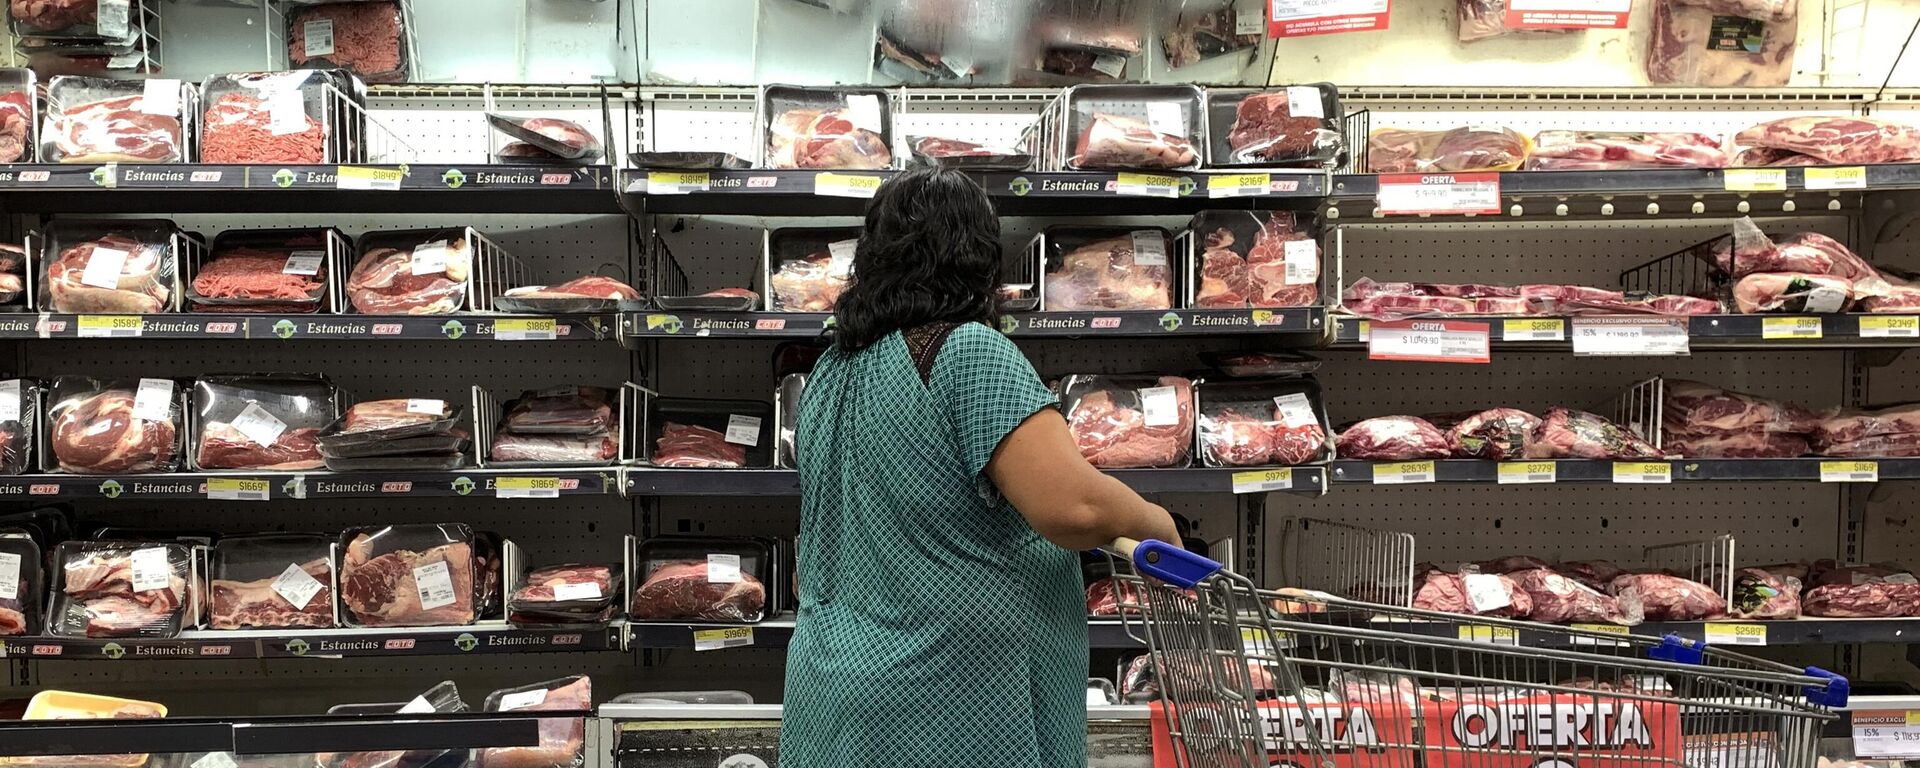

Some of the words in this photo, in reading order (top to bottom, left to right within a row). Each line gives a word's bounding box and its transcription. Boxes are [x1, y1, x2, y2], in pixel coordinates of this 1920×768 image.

[124, 170, 184, 182] Estancias
[307, 172, 337, 182] Esta
[373, 171, 396, 180] $1849
[476, 172, 534, 184] Estancias
[542, 174, 571, 184] COTO
[680, 175, 702, 184] $1849
[1421, 176, 1456, 184] OFERTA
[1042, 180, 1100, 191] Estancias
[1146, 176, 1172, 186] $2089
[1240, 176, 1262, 186] $2169
[1192, 315, 1248, 326] Estancias
[1260, 312, 1271, 321] $2
[113, 318, 136, 328] $1589
[142, 320, 200, 332] Estancias
[206, 322, 236, 332] COTO
[307, 322, 366, 334] Estancias
[372, 324, 402, 334] COTO
[526, 321, 550, 331] $1869
[693, 318, 750, 329] Estancias
[756, 320, 786, 330] COTO
[1029, 318, 1086, 328] Estancias
[1092, 318, 1121, 328] COTO
[1412, 322, 1446, 331] OFERTA
[1532, 322, 1556, 331] $2589
[1797, 320, 1817, 328] $1169
[1888, 319, 1912, 328] $2349
[1401, 464, 1426, 474] $2639
[1528, 464, 1552, 474] $2779
[1644, 464, 1666, 474] $2519
[1854, 463, 1874, 472] $1169
[1265, 472, 1286, 482] $979
[134, 482, 193, 494] Estancias
[239, 481, 263, 491] $1669
[316, 482, 376, 493] Estancias
[382, 482, 412, 492] COTO
[530, 479, 554, 488] $1869
[30, 484, 60, 494] COTO
[724, 628, 747, 638] $1969
[1736, 626, 1760, 636] $2589
[320, 640, 379, 650] Estancias
[385, 639, 415, 648] COTO
[488, 634, 546, 646] Estancias
[552, 634, 582, 644] COTO
[33, 646, 62, 655] COTO
[136, 645, 194, 656] Estancias
[201, 646, 230, 656] COTO
[1452, 703, 1650, 747] OFERTA
[1864, 728, 1880, 736] 15%
[1894, 732, 1900, 741] $
